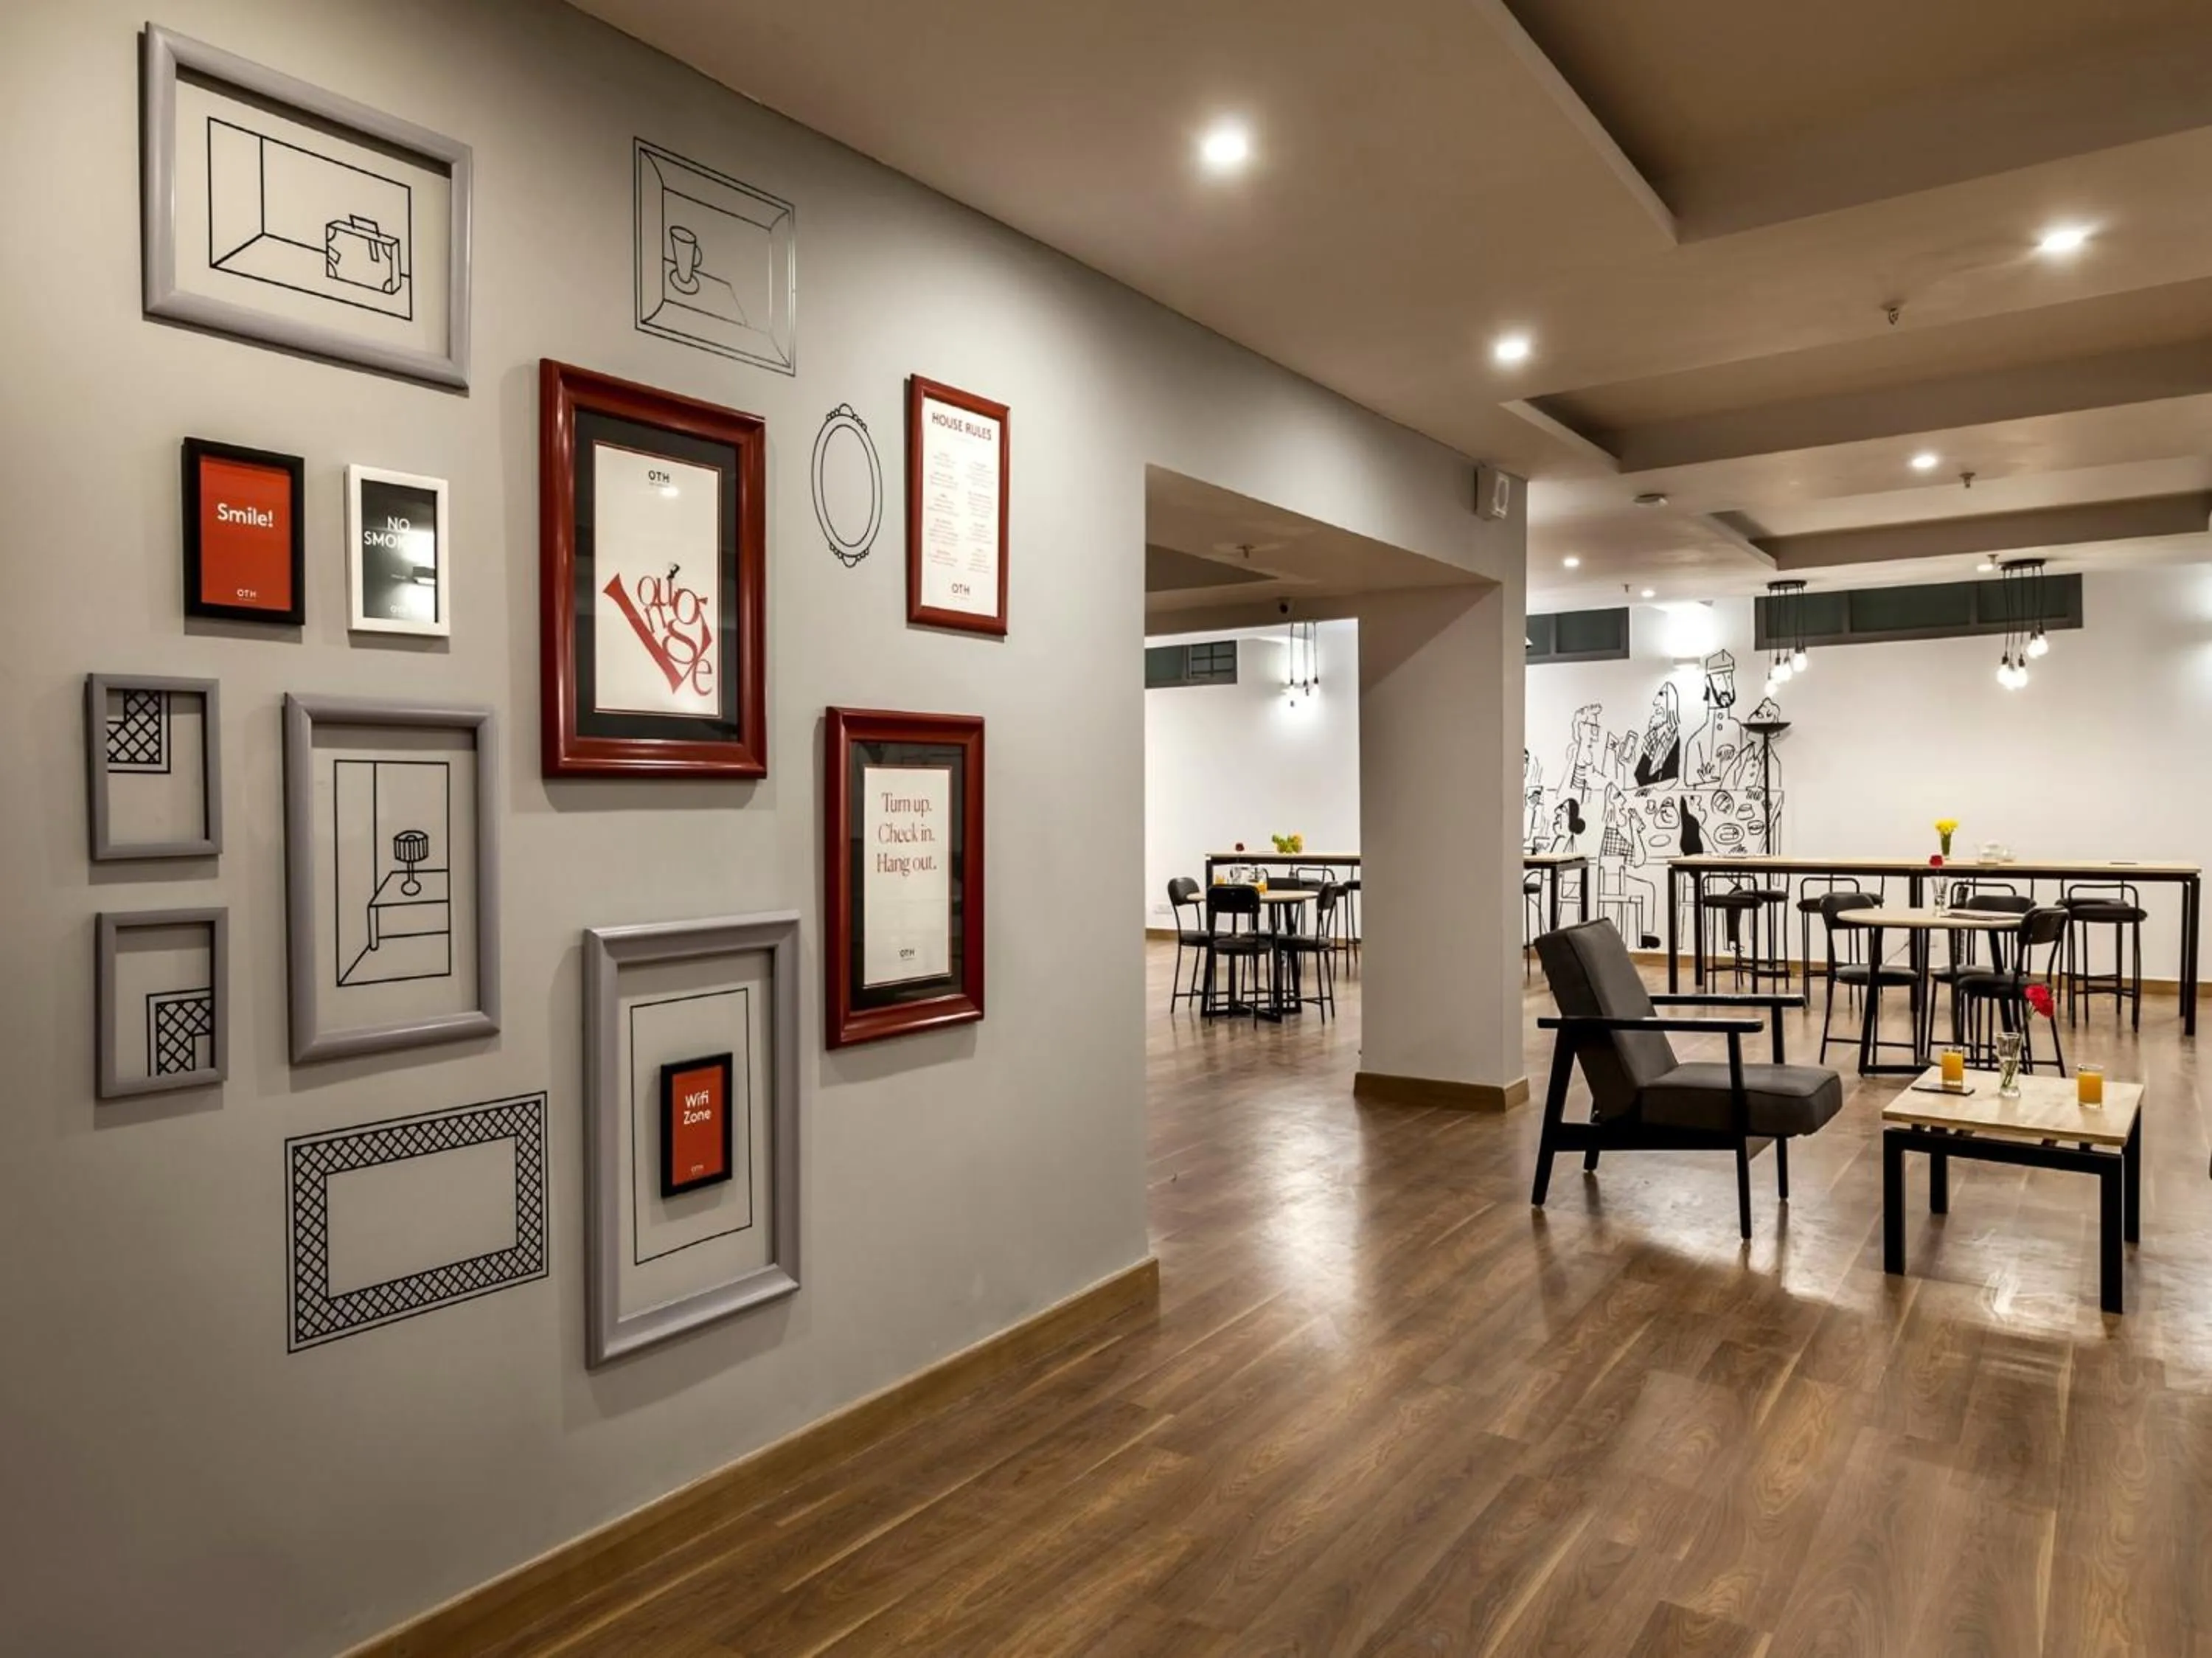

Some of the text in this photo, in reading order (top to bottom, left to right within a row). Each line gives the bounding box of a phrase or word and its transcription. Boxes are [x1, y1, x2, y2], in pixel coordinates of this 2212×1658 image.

[931, 412, 992, 441] HOUSE RULES
[218, 502, 274, 528] Smile!
[387, 515, 411, 532] NO
[881, 792, 933, 818] Turn up.
[878, 822, 936, 844] Check in.
[877, 853, 937, 877] Hang out.
[684, 1089, 709, 1109] Wifi
[683, 1109, 712, 1125] Zone
